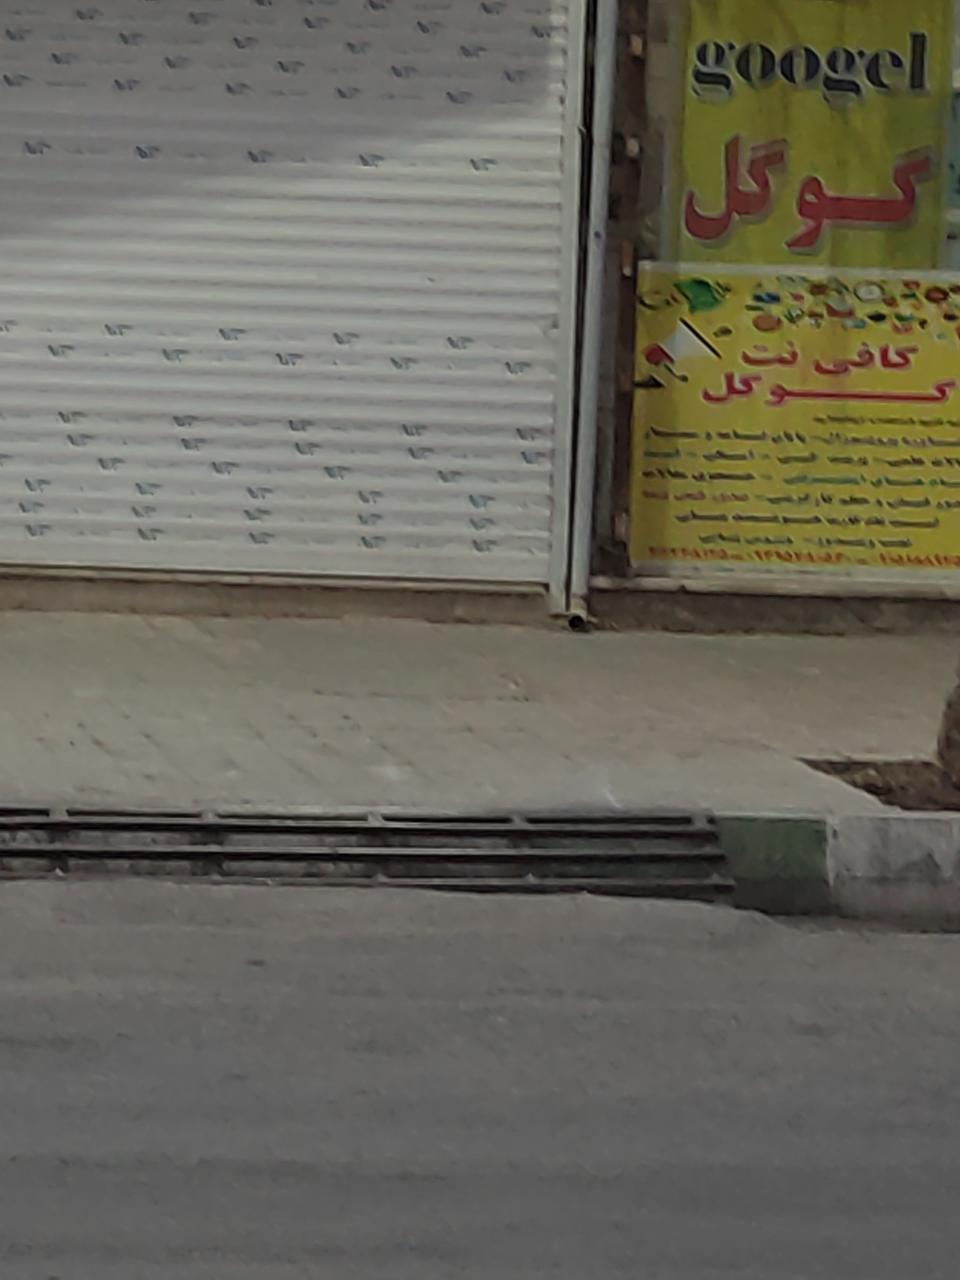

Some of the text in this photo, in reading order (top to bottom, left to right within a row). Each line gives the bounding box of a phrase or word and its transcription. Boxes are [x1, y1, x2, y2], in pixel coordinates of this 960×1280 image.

[692, 32, 927, 102] googel
[741, 341, 918, 375] کافی نت
